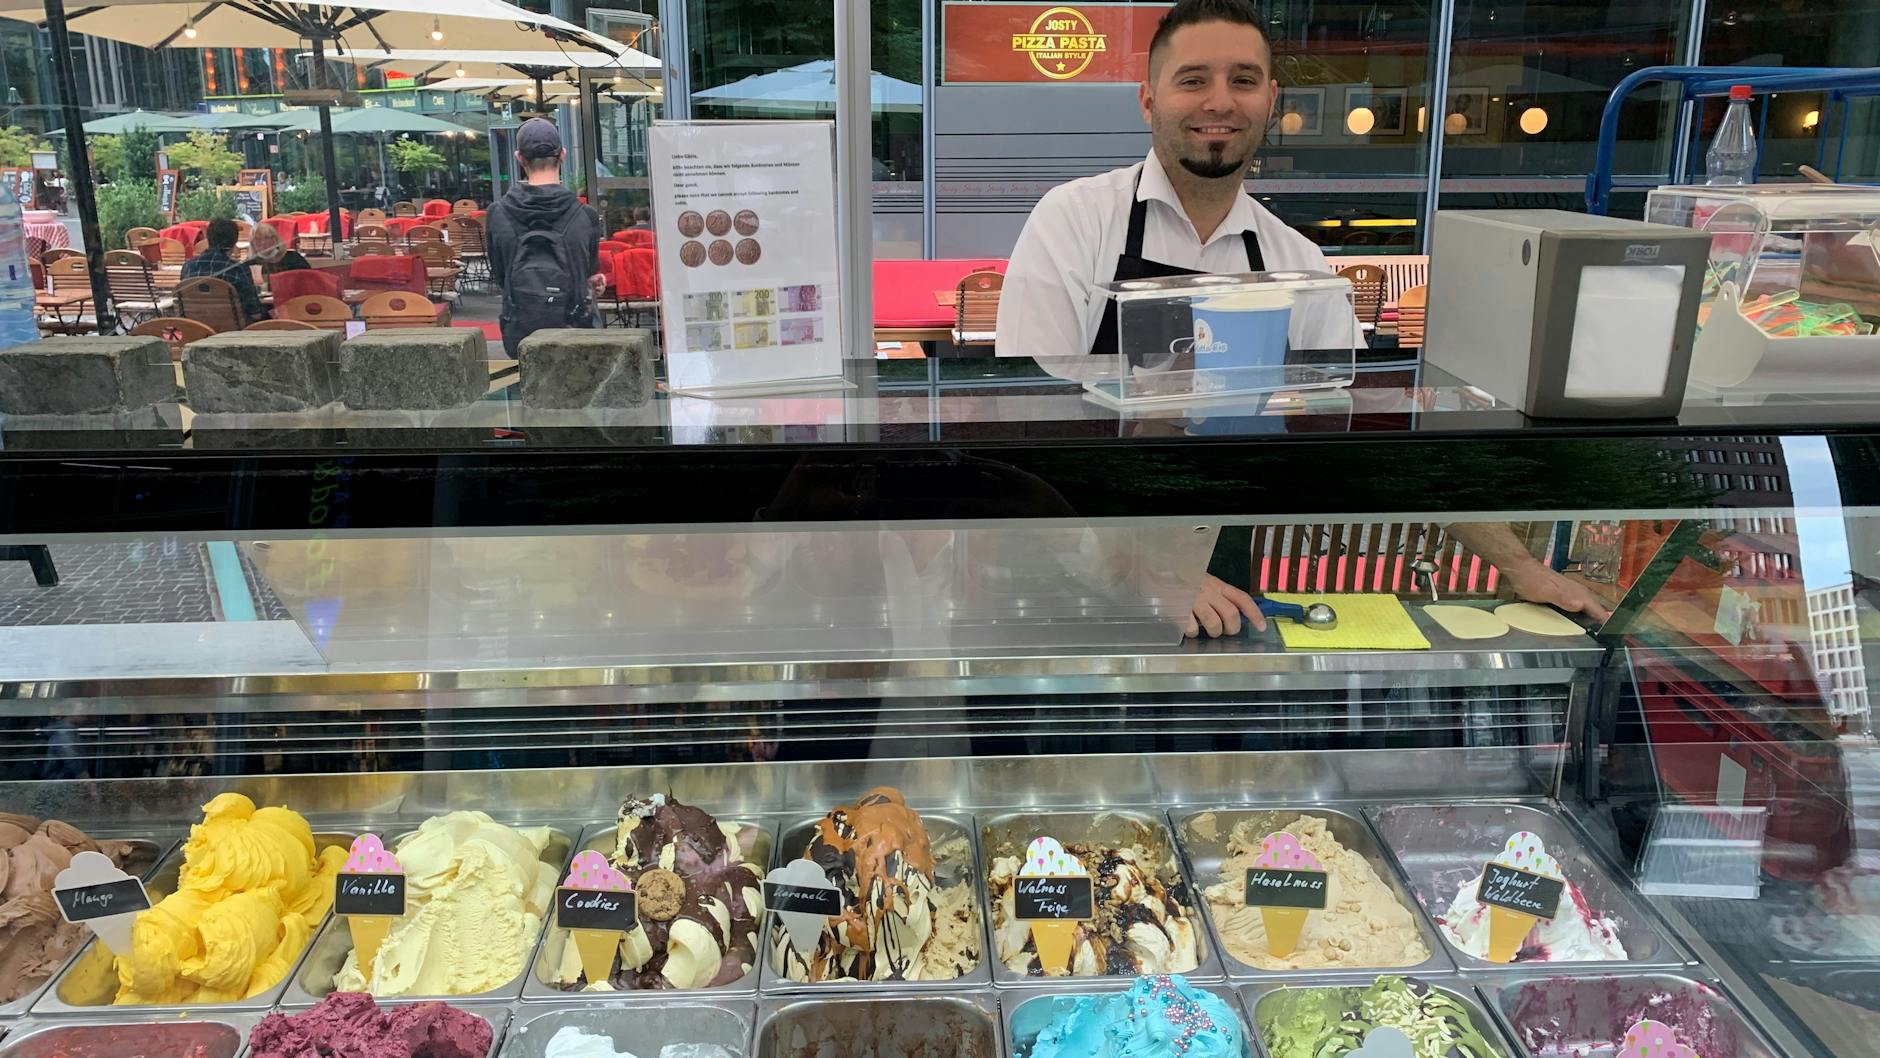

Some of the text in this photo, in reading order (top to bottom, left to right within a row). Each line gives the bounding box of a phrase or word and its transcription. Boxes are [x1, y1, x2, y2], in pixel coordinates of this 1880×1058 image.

[1045, 19, 1078, 31] JOSTY
[1012, 36, 1106, 49] PIZZA PASTA
[340, 878, 397, 897] Vanille
[1017, 878, 1067, 895] Walnuss
[1250, 867, 1324, 890] Haselnuss
[1488, 868, 1540, 892] Joghurt
[72, 890, 114, 909] Mango
[564, 890, 621, 912] Cookies
